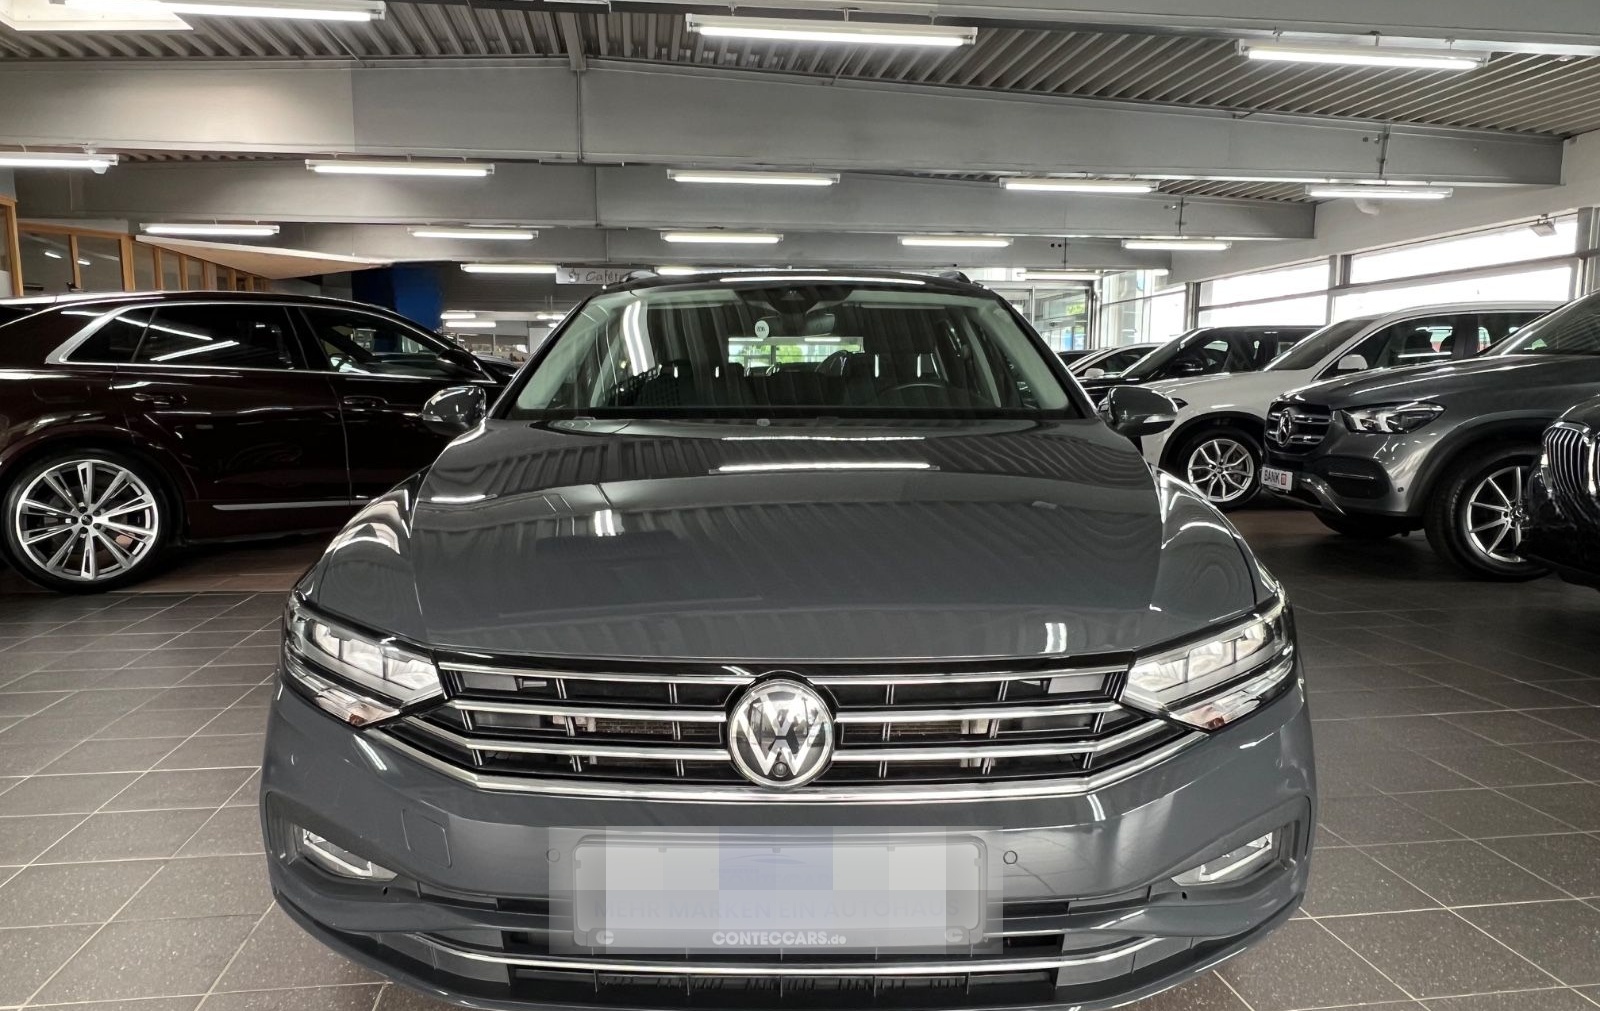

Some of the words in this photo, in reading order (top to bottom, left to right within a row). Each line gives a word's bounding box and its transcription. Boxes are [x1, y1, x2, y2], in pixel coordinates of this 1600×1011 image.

[594, 901, 661, 919] MEHR
[668, 901, 771, 919] MARKEN
[779, 901, 815, 918] EIN
[824, 899, 959, 918] AUTOHAUS
[712, 931, 847, 946] CONTECCARS.de
